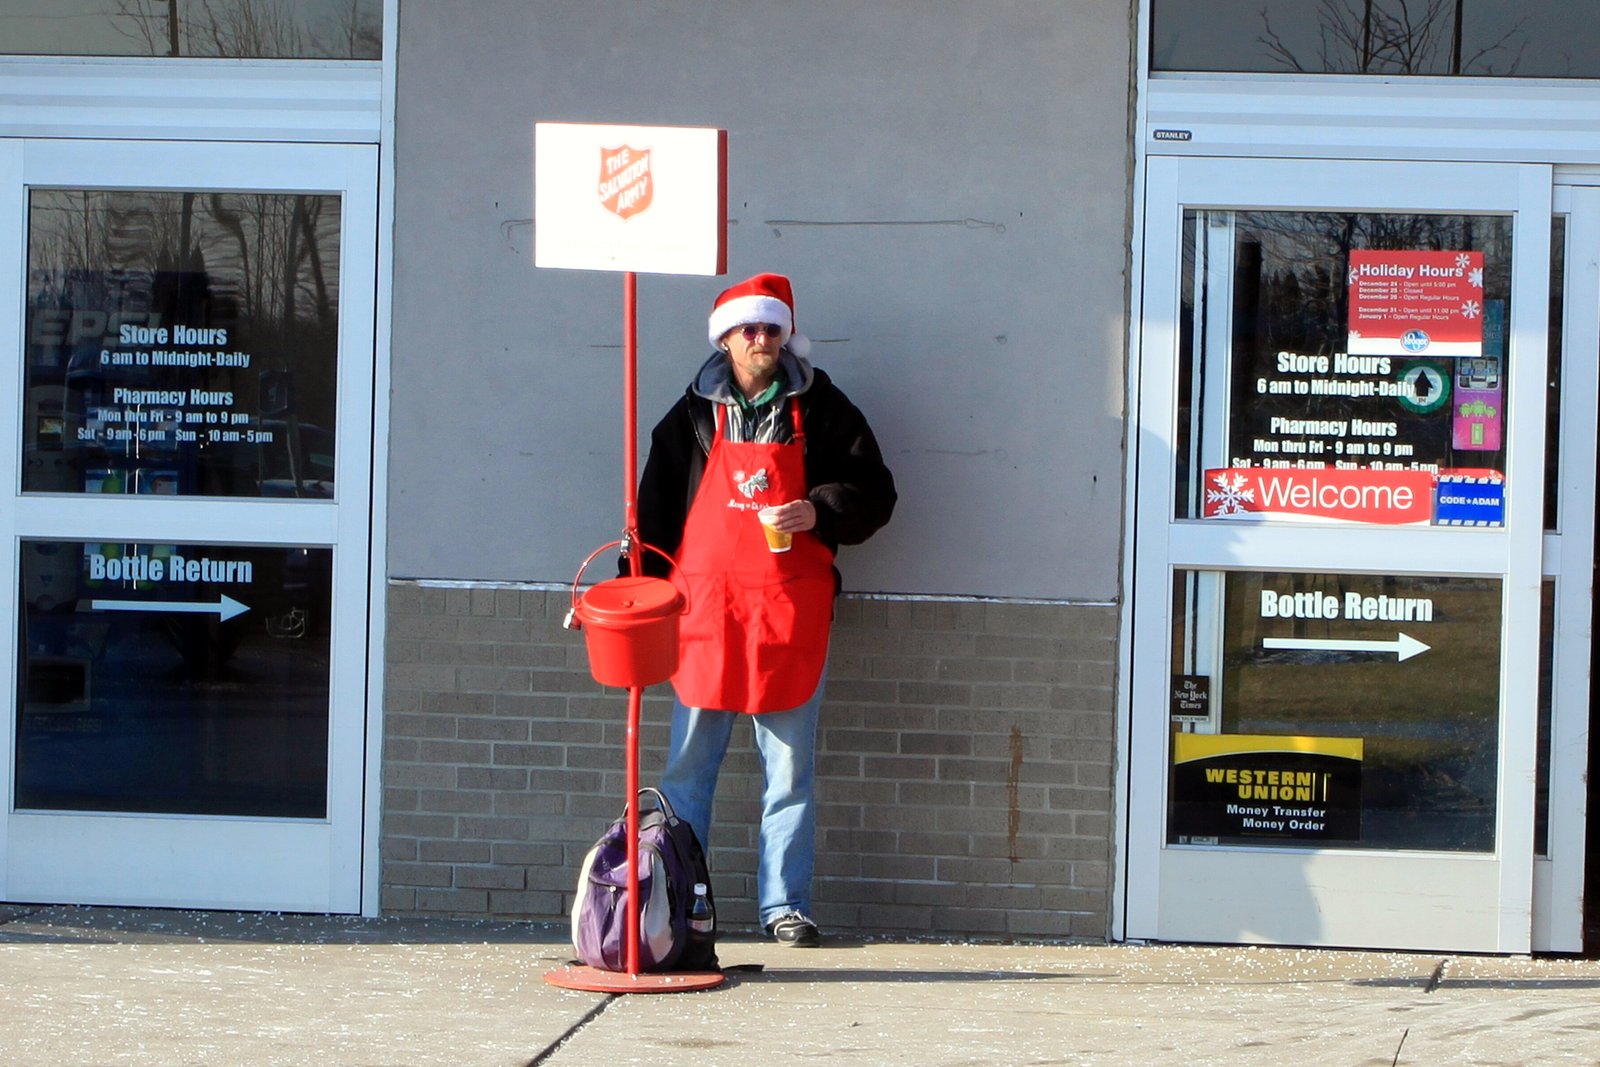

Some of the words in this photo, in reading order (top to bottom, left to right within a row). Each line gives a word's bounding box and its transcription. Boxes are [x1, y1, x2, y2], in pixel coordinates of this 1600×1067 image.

[606, 149, 629, 174] THE
[600, 153, 649, 202] SALVATION
[616, 177, 648, 213] ARMY
[1360, 264, 1414, 278] Holiday
[1420, 264, 1464, 277] Hours
[119, 324, 168, 345] Store
[173, 325, 228, 346] Hours
[100, 350, 109, 365] 6
[112, 352, 133, 365] am
[136, 352, 149, 365] to
[152, 351, 250, 368] Midnight-Daily
[1277, 352, 1329, 373] Store
[1334, 353, 1391, 375] Hours
[1257, 378, 1267, 394] 6
[1269, 381, 1292, 394] am
[1294, 380, 1309, 394] to
[1311, 379, 1415, 397] Midnight-Daily
[113, 388, 186, 406] Pharmacy
[190, 388, 234, 406] Hours
[98, 409, 121, 422] Mon
[125, 409, 147, 423] thru
[150, 410, 164, 423] Fri
[175, 410, 183, 422] 9
[185, 412, 203, 423] am
[206, 411, 217, 423] to
[220, 411, 228, 424] 9
[231, 412, 249, 425] pm
[77, 427, 96, 441] Sat
[175, 428, 197, 442] Sun
[1270, 417, 1348, 437] Pharmacy
[1351, 418, 1397, 437] Hours
[1253, 439, 1279, 453] Mon
[1281, 440, 1306, 453] thru
[1308, 440, 1323, 454] Fri
[1335, 441, 1343, 454] 9
[1346, 443, 1364, 455] am
[1367, 442, 1380, 455] to
[1383, 442, 1391, 455] 9
[1394, 444, 1413, 457] pm
[1232, 457, 1251, 468] Sat
[1335, 460, 1357, 470] Sun
[1258, 476, 1413, 510] Welcome
[1440, 496, 1465, 505] CODE
[1472, 498, 1500, 506] ADAM
[89, 554, 164, 581] Bottle
[169, 555, 253, 583] Return
[1260, 590, 1339, 619] Bottle
[1344, 592, 1434, 622] Return
[1184, 680, 1197, 690] The
[1174, 690, 1189, 699] New
[1190, 690, 1208, 701] York
[1180, 700, 1202, 709] Times
[1205, 768, 1311, 785] WESTERN
[1238, 785, 1311, 802] UNION
[1226, 804, 1269, 817] Money
[1272, 806, 1326, 818] Transfer
[1242, 818, 1285, 831] Money
[1289, 819, 1325, 831] Order
